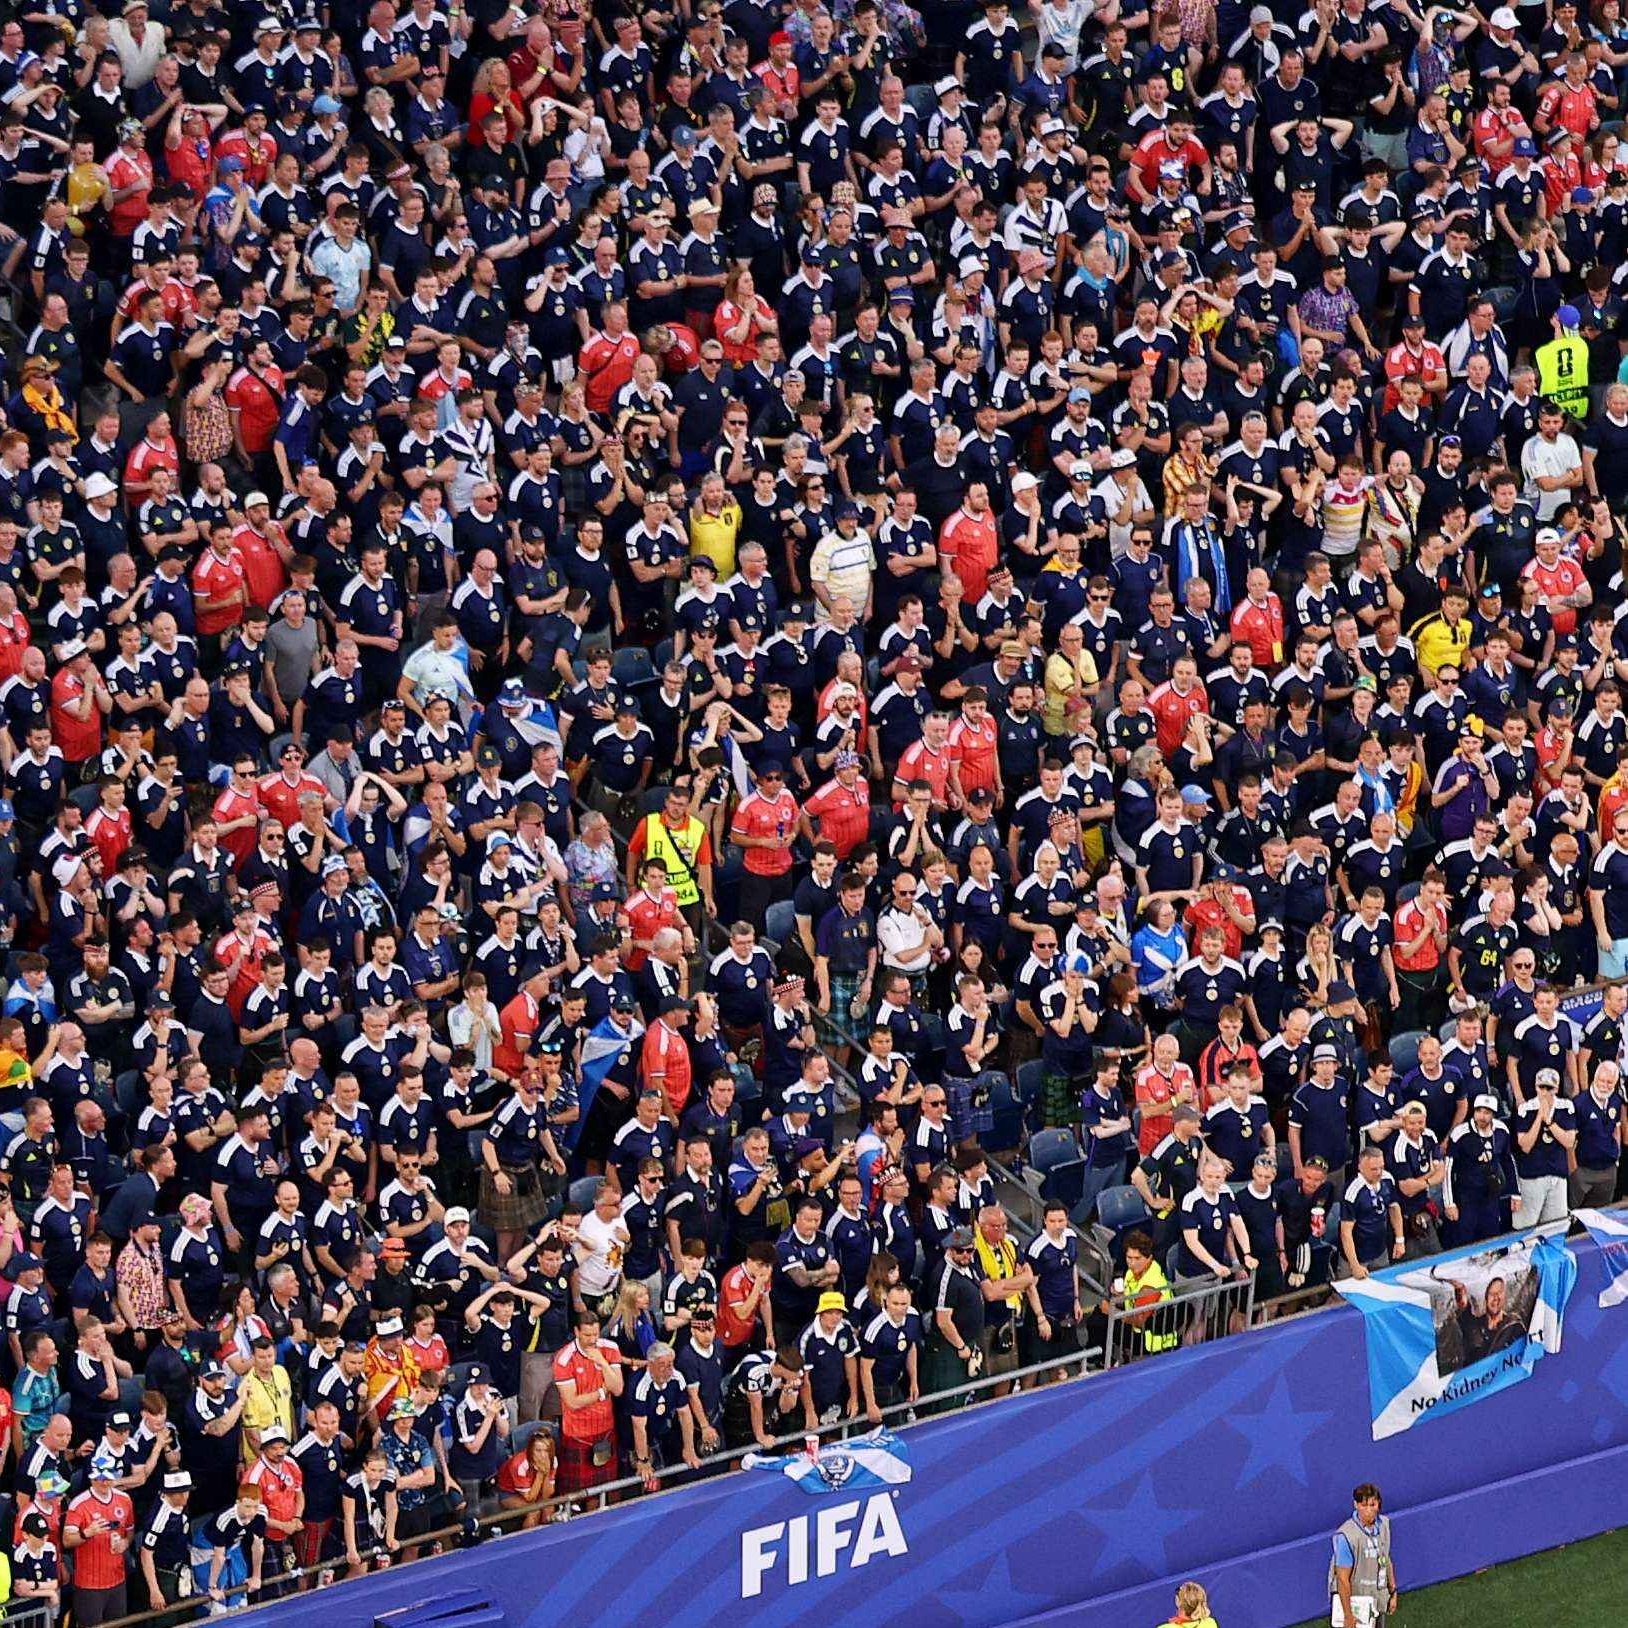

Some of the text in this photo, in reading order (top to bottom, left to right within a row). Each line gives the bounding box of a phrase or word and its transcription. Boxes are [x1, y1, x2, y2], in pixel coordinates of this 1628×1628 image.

[1410, 1396, 1437, 1413] No
[1441, 1366, 1499, 1404] Kidney
[741, 1492, 909, 1599] FIFA
